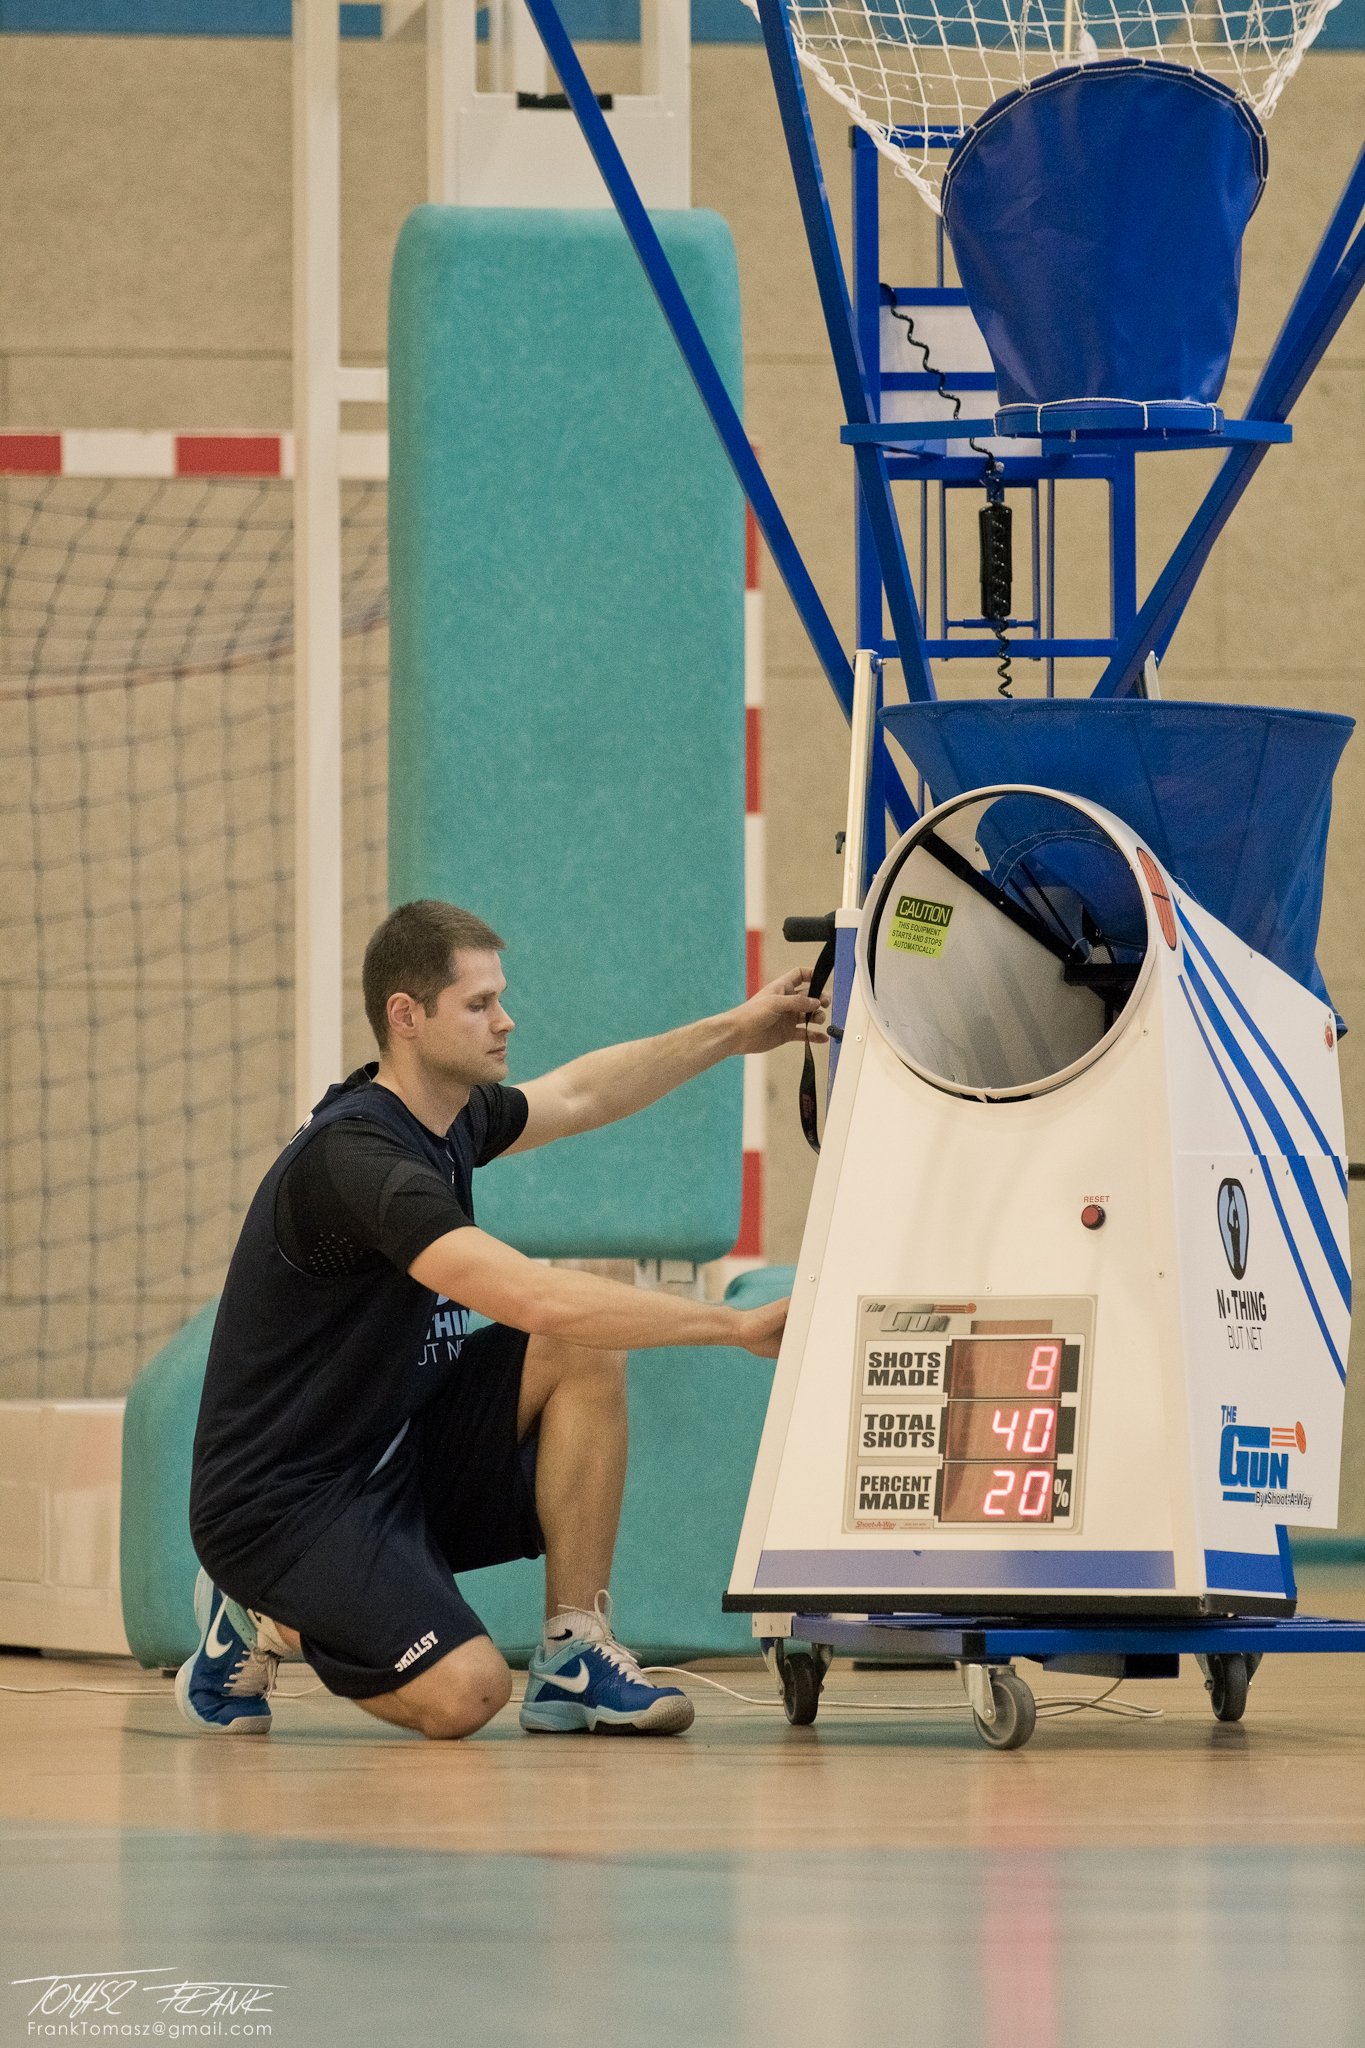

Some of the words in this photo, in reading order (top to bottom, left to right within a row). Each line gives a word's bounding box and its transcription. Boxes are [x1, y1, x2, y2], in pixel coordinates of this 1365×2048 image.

[900, 899, 950, 924] CAUTION
[898, 921, 910, 930] THIS
[910, 924, 941, 936] EQUIPMENT
[892, 929, 912, 940] STARTS
[912, 934, 924, 943] AND
[924, 936, 942, 947] STOPS
[893, 940, 936, 955] AUTOMATICALLY
[1083, 1195, 1110, 1203] RESET
[1227, 1325, 1244, 1350] BUT
[1245, 1326, 1263, 1351] NET
[868, 1351, 941, 1369] SHOTS
[1026, 1346, 1059, 1391] 8
[867, 1369, 939, 1387] MADE
[864, 1413, 936, 1431] TOTAL
[1221, 1405, 1237, 1427] THE
[862, 1431, 935, 1448] SHOTS
[992, 1408, 1055, 1453] 40
[1219, 1424, 1289, 1489] GUN
[860, 1475, 932, 1493] PERCENT
[983, 1470, 1051, 1516] 20
[859, 1493, 930, 1511] MADE
